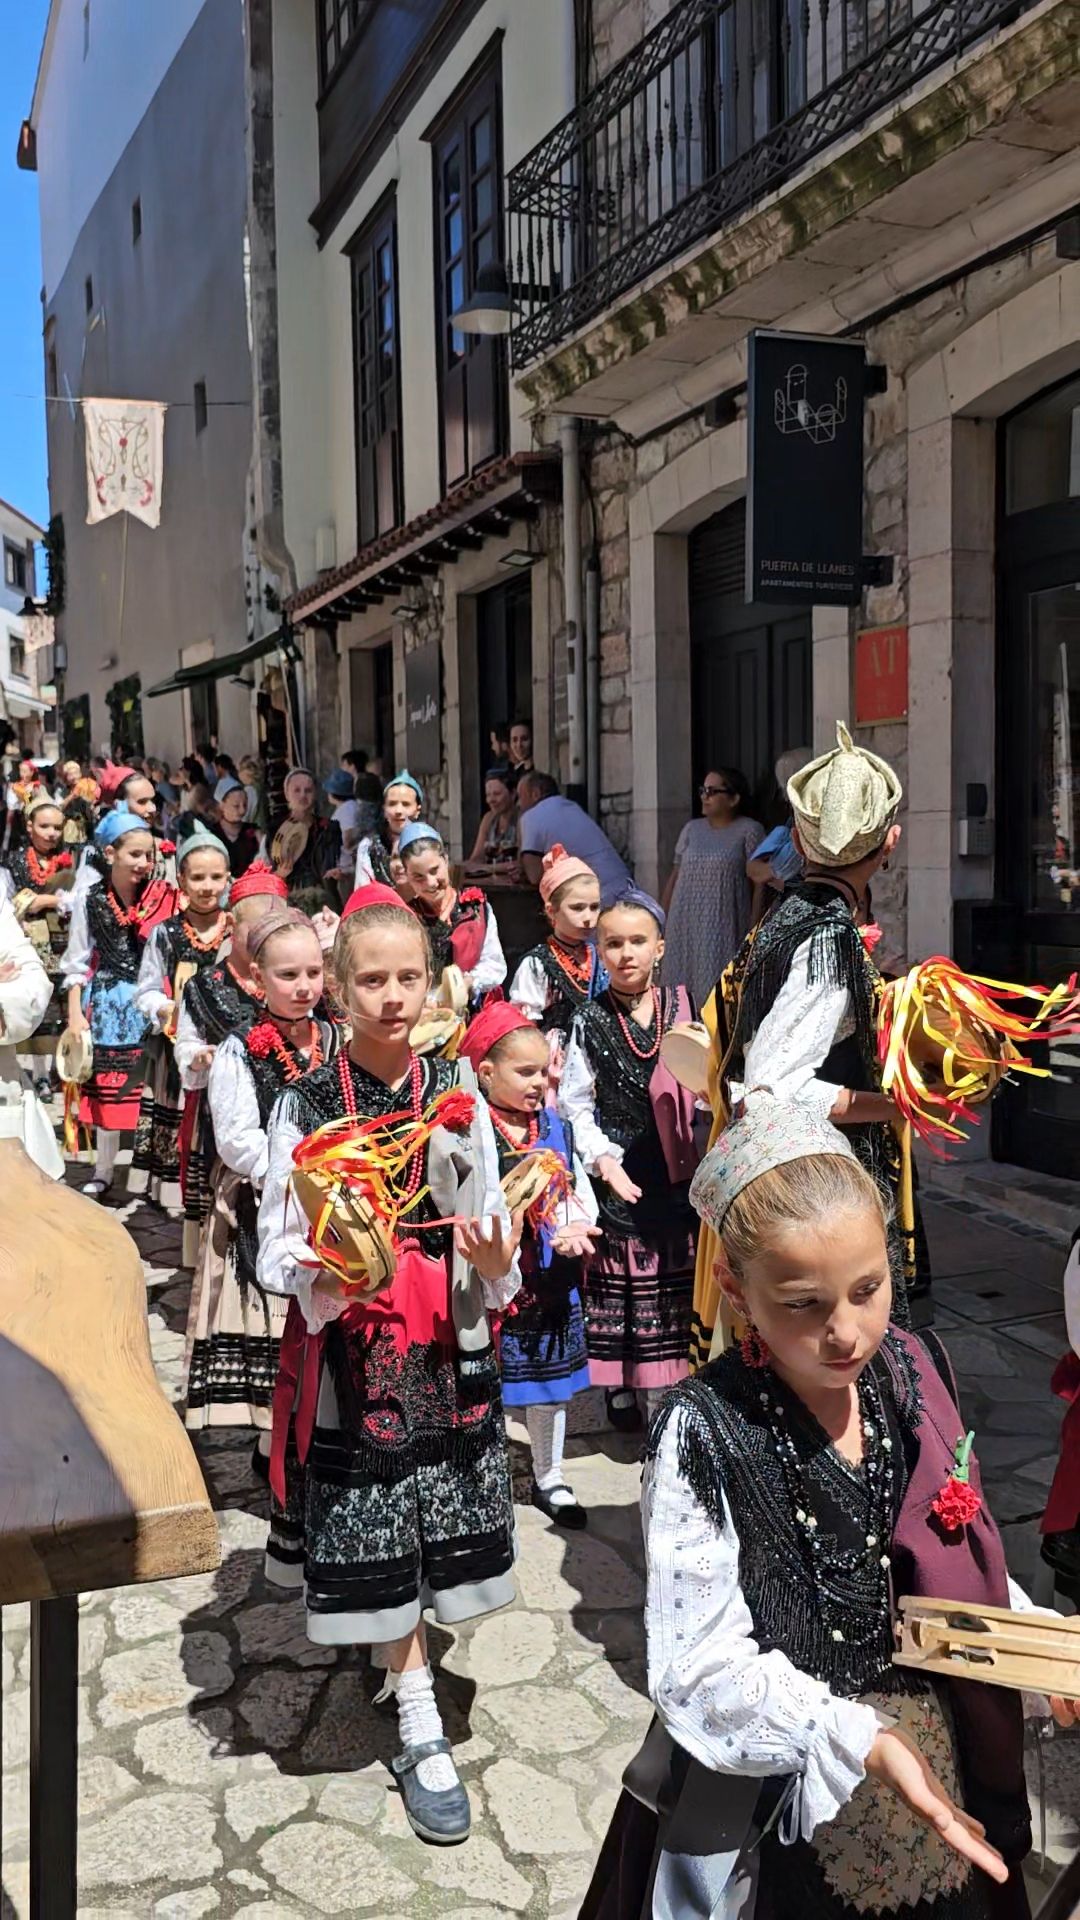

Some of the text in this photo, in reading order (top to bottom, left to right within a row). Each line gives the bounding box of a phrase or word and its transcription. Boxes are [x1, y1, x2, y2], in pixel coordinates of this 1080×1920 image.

[760, 559, 855, 576] PUERTA DE LLANES
